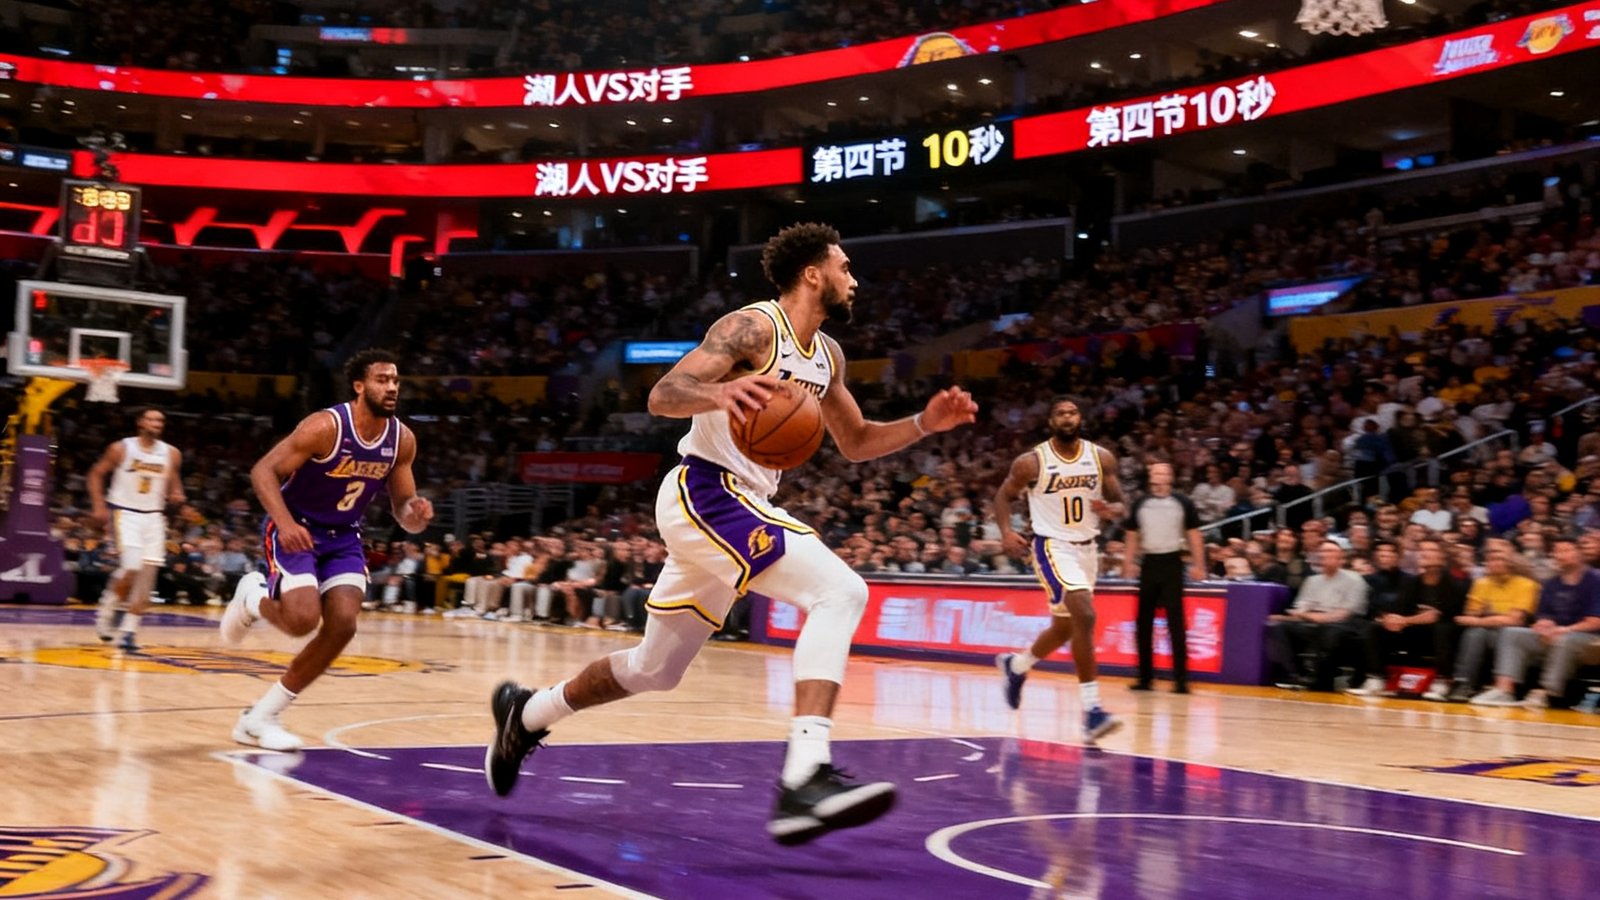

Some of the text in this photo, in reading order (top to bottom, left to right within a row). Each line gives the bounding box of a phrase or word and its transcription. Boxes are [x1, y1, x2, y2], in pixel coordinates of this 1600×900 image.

[523, 66, 694, 106] 湖人VS对手
[1086, 75, 1277, 148] 第四节10秒
[811, 124, 1005, 183] 第四节 10秒
[534, 156, 709, 197] 湖人VS对手
[1063, 496, 1083, 525] 10
